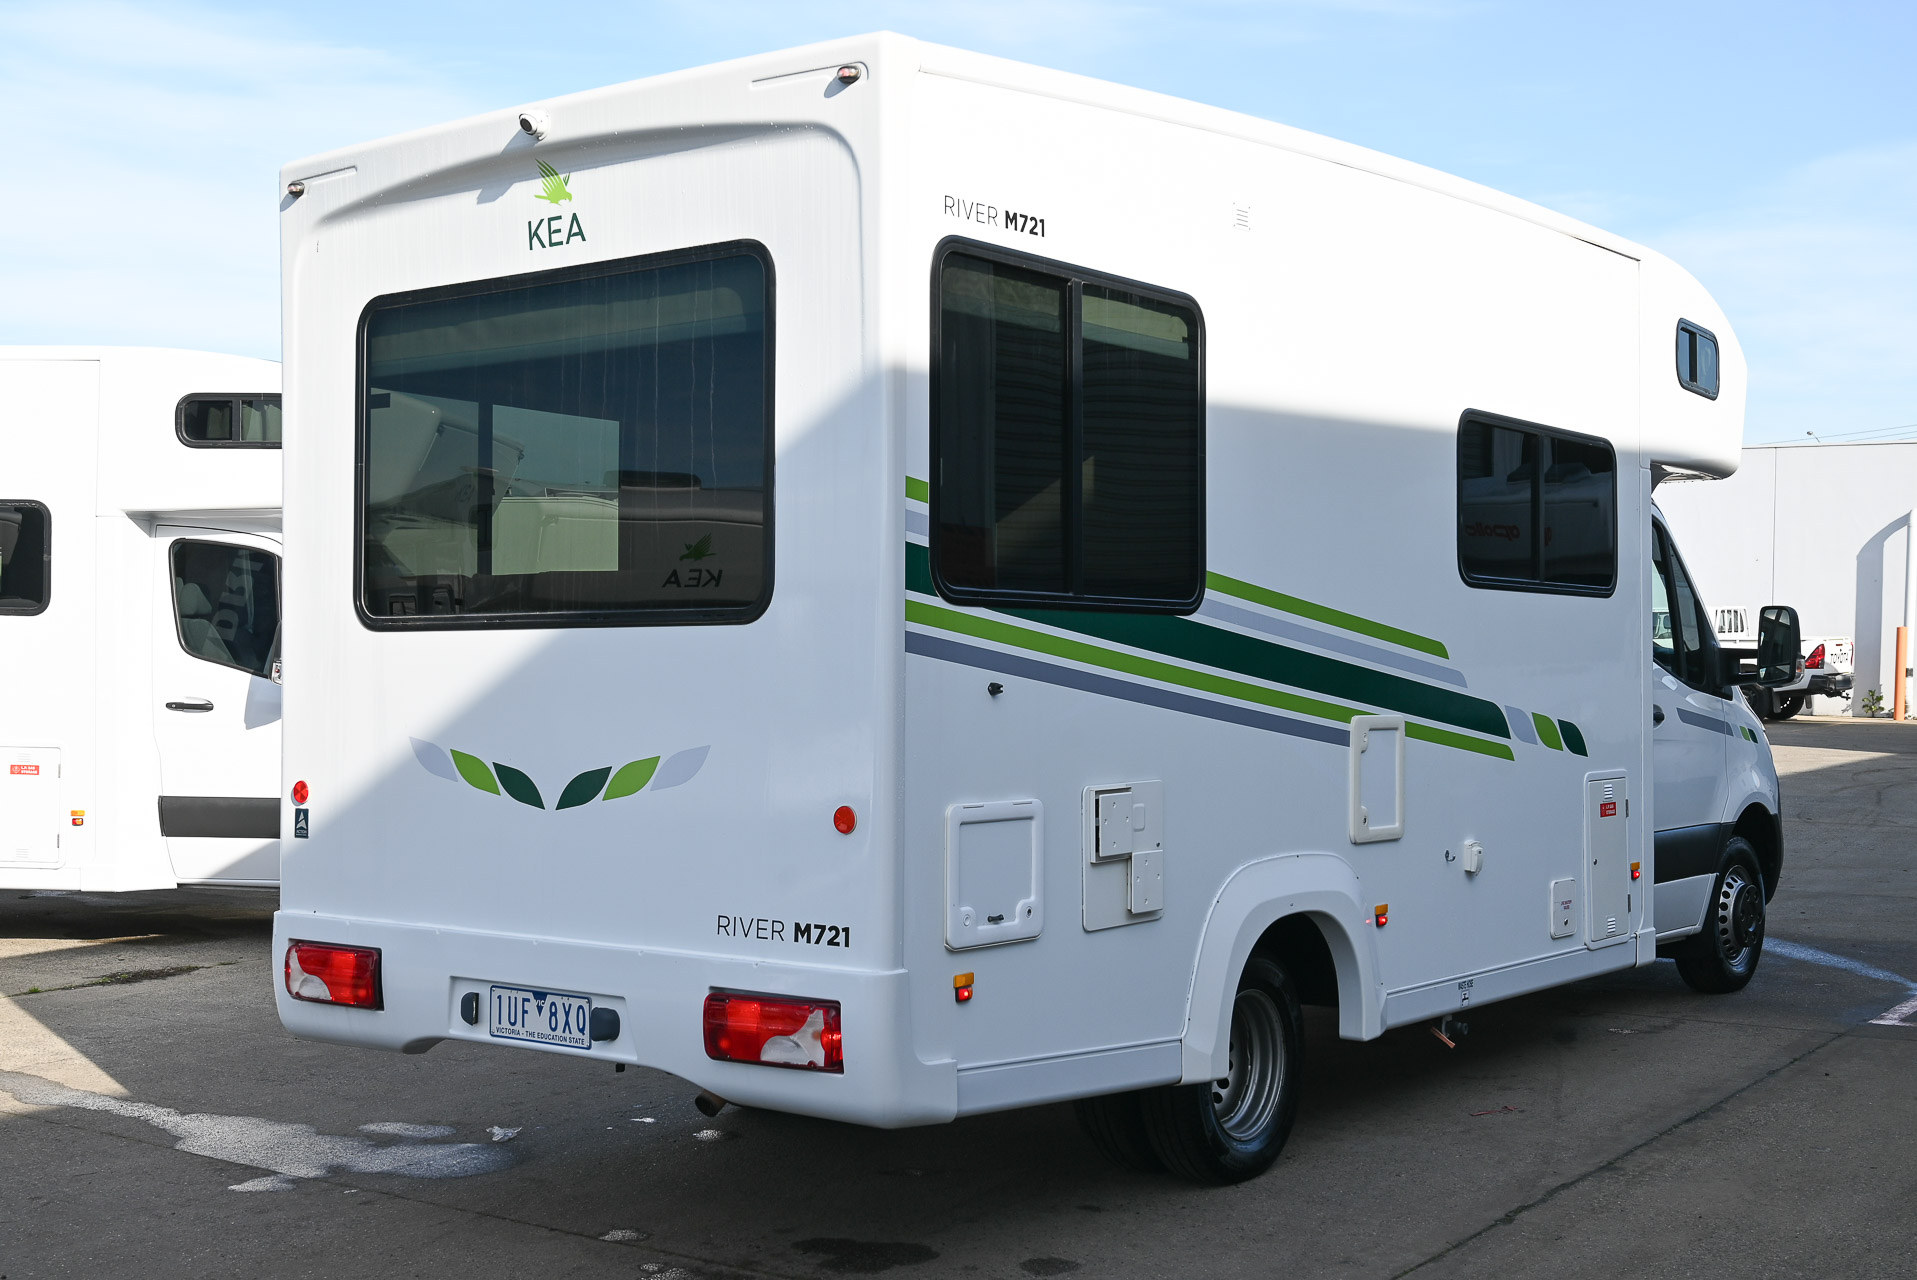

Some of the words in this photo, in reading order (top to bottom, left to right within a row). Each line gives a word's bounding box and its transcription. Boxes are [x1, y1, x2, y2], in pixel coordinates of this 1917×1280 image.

[528, 212, 587, 251] KEA
[944, 195, 998, 227] RIVER
[1005, 210, 1045, 238] M721
[1830, 652, 1849, 664] TOYOTA
[717, 914, 785, 942] RIVER
[794, 921, 850, 948] M721
[496, 994, 531, 1029] 1UF
[548, 1000, 587, 1036] 8XQ
[495, 1026, 521, 1036] VICTORIA
[525, 1030, 536, 1039] THE
[537, 1032, 568, 1043] EDUCATION
[568, 1036, 585, 1046] STATE
